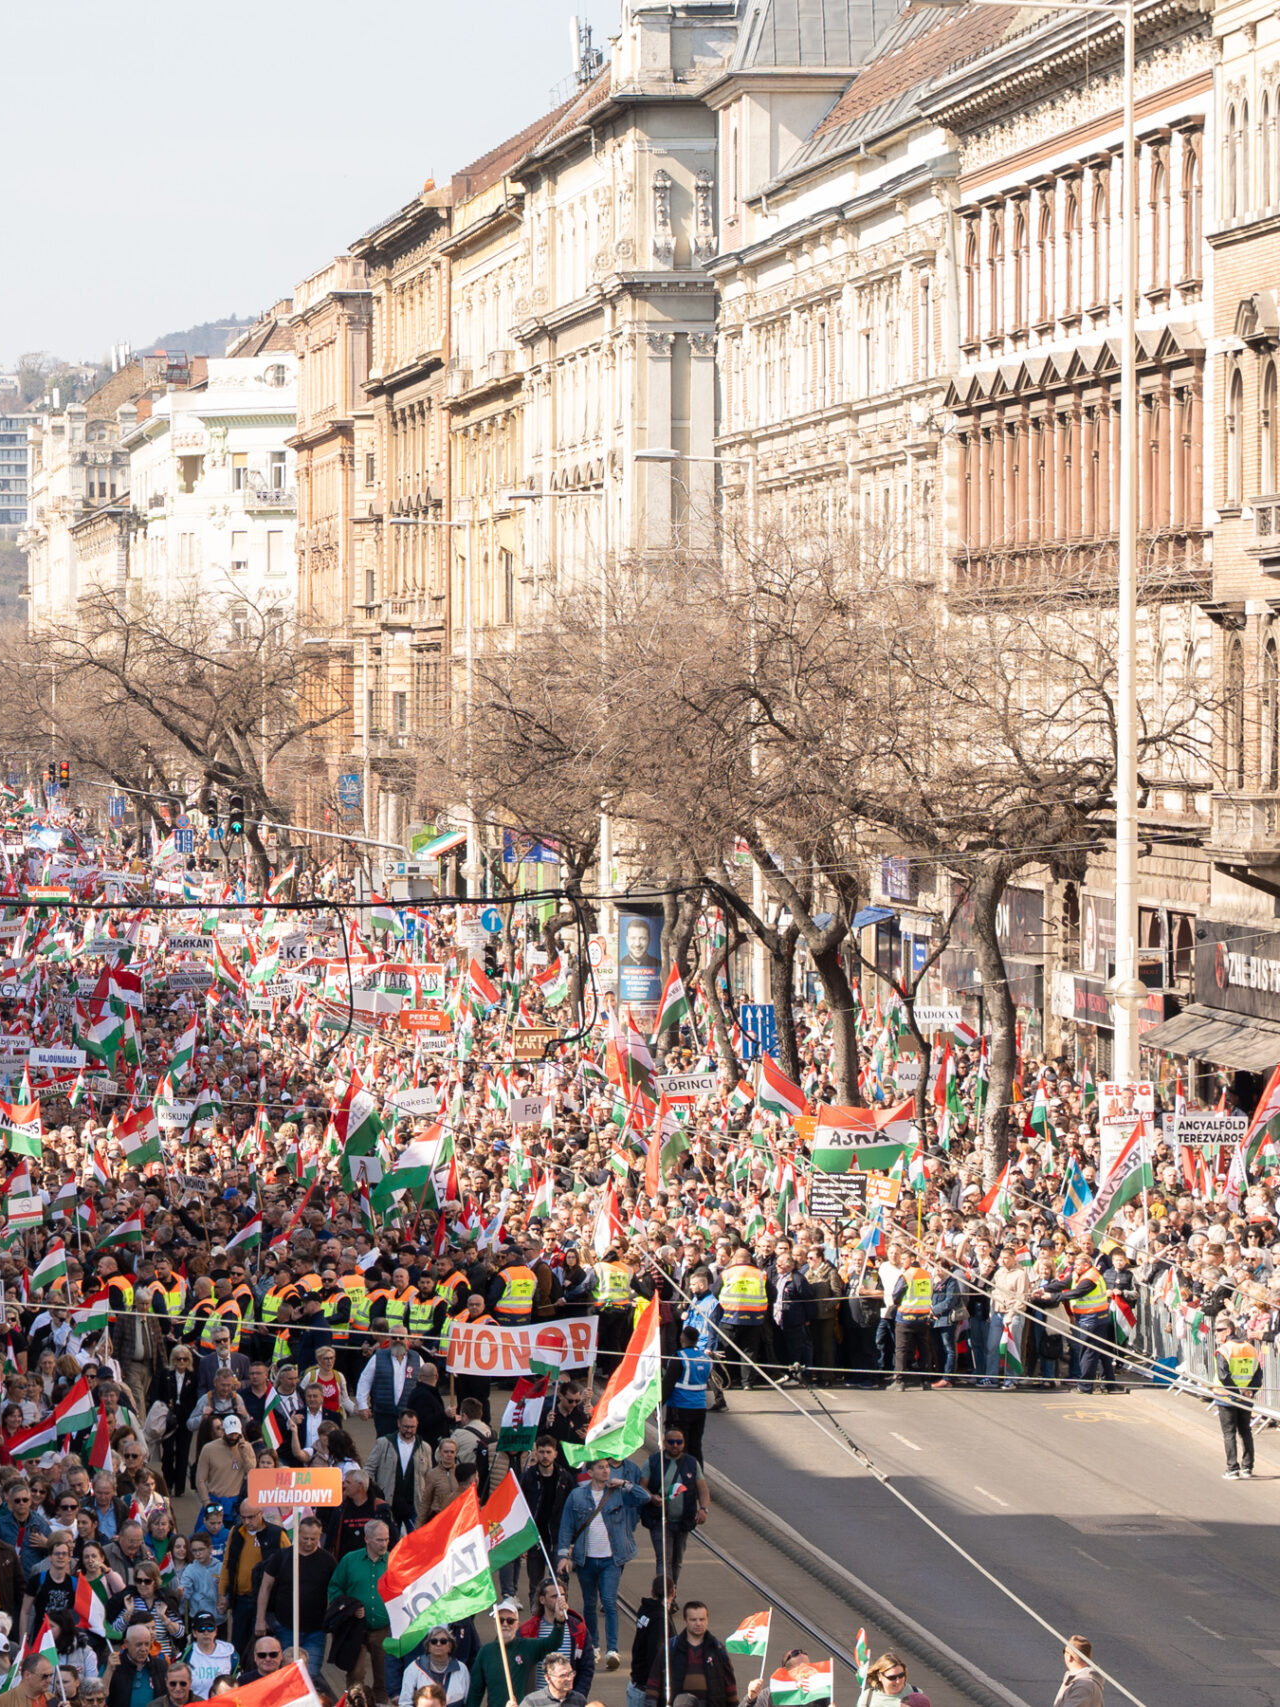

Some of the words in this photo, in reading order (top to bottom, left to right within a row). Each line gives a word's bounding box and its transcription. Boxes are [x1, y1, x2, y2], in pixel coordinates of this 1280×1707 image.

[914, 1010, 960, 1020] MADOCSA
[660, 1077, 713, 1093] LŐRINCI
[524, 1104, 543, 1115] Fót
[1178, 1118, 1246, 1131] ANGYALFÖLD
[1177, 1130, 1245, 1144] TERÉZVÁROS
[447, 1322, 593, 1370] MONOR
[275, 1469, 312, 1488] HAJRÁ
[257, 1486, 333, 1504] NYÍRADONY!
